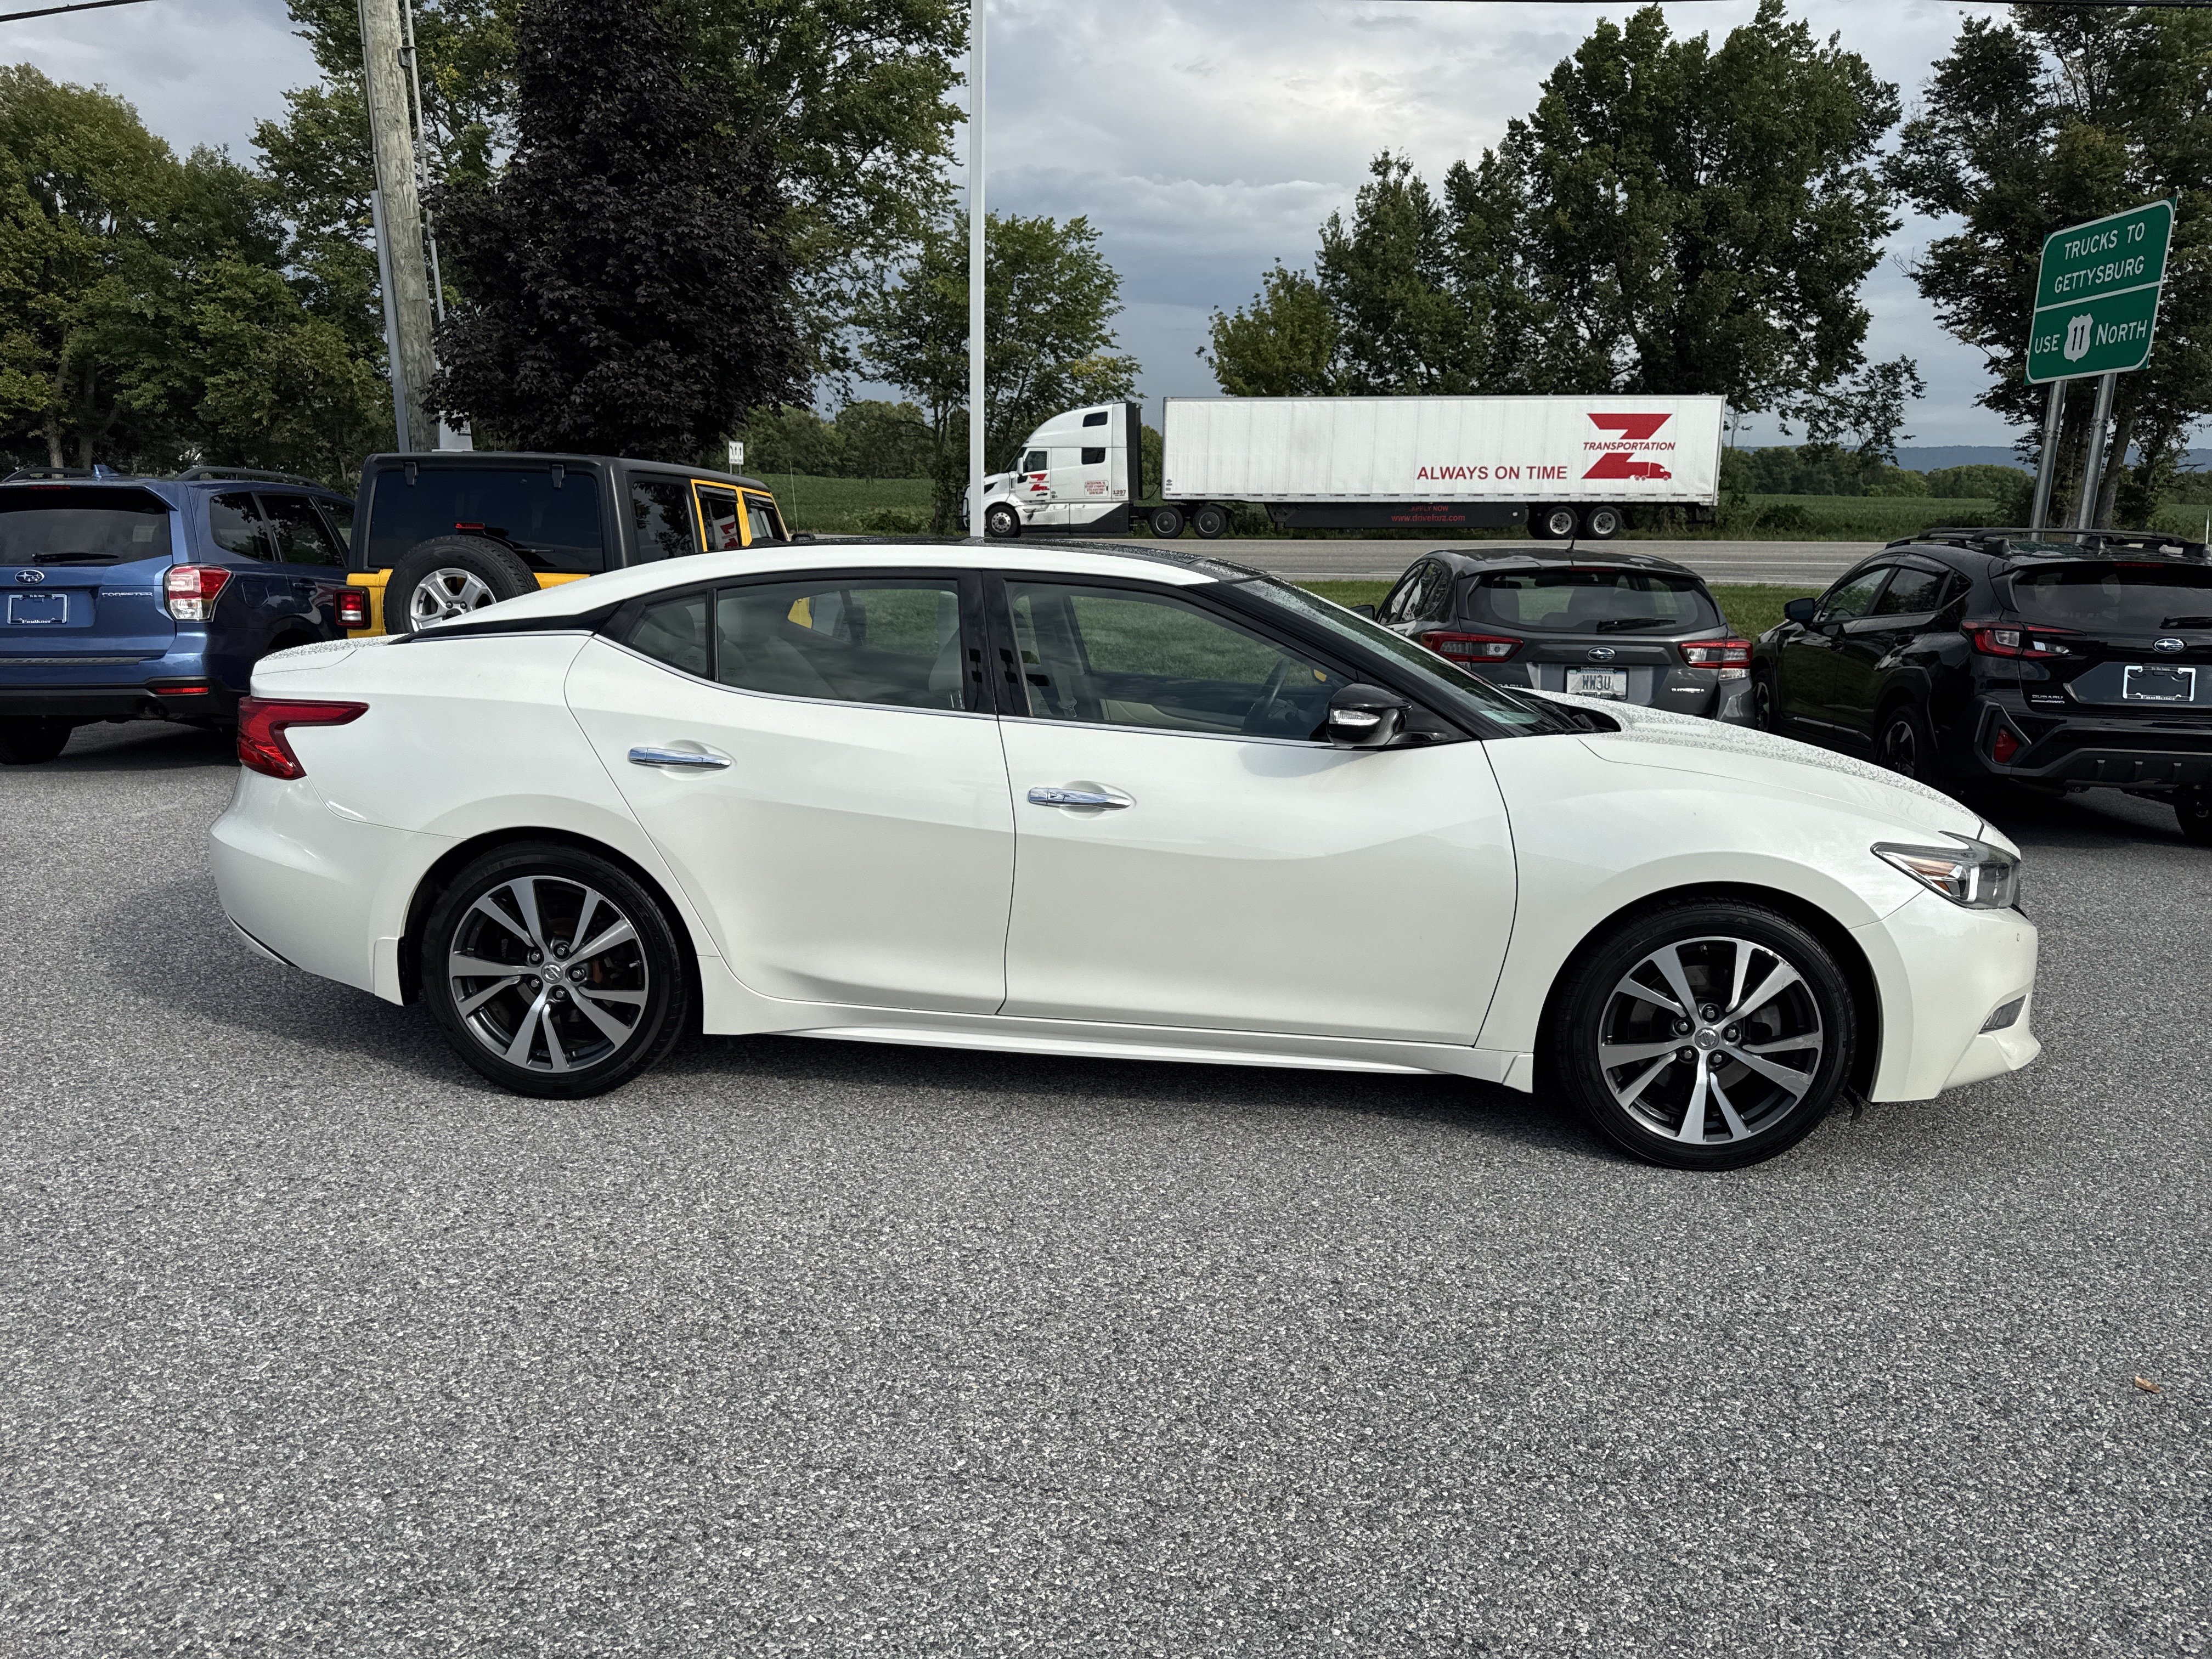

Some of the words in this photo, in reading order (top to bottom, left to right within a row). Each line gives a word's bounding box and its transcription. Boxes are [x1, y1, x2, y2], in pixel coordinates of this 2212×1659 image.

[2064, 230, 2118, 260] TRUCKS
[2127, 222, 2145, 243] TO
[2055, 256, 2145, 294] GETTYSBURG
[2035, 334, 2060, 354] USE
[2072, 324, 2085, 351] 11
[2096, 320, 2147, 346] NORTH
[1583, 442, 1676, 450] TRANSPORTATION
[1417, 466, 1488, 480] ALWAYS
[1495, 466, 1520, 480] ON
[1526, 466, 1567, 480] TIME
